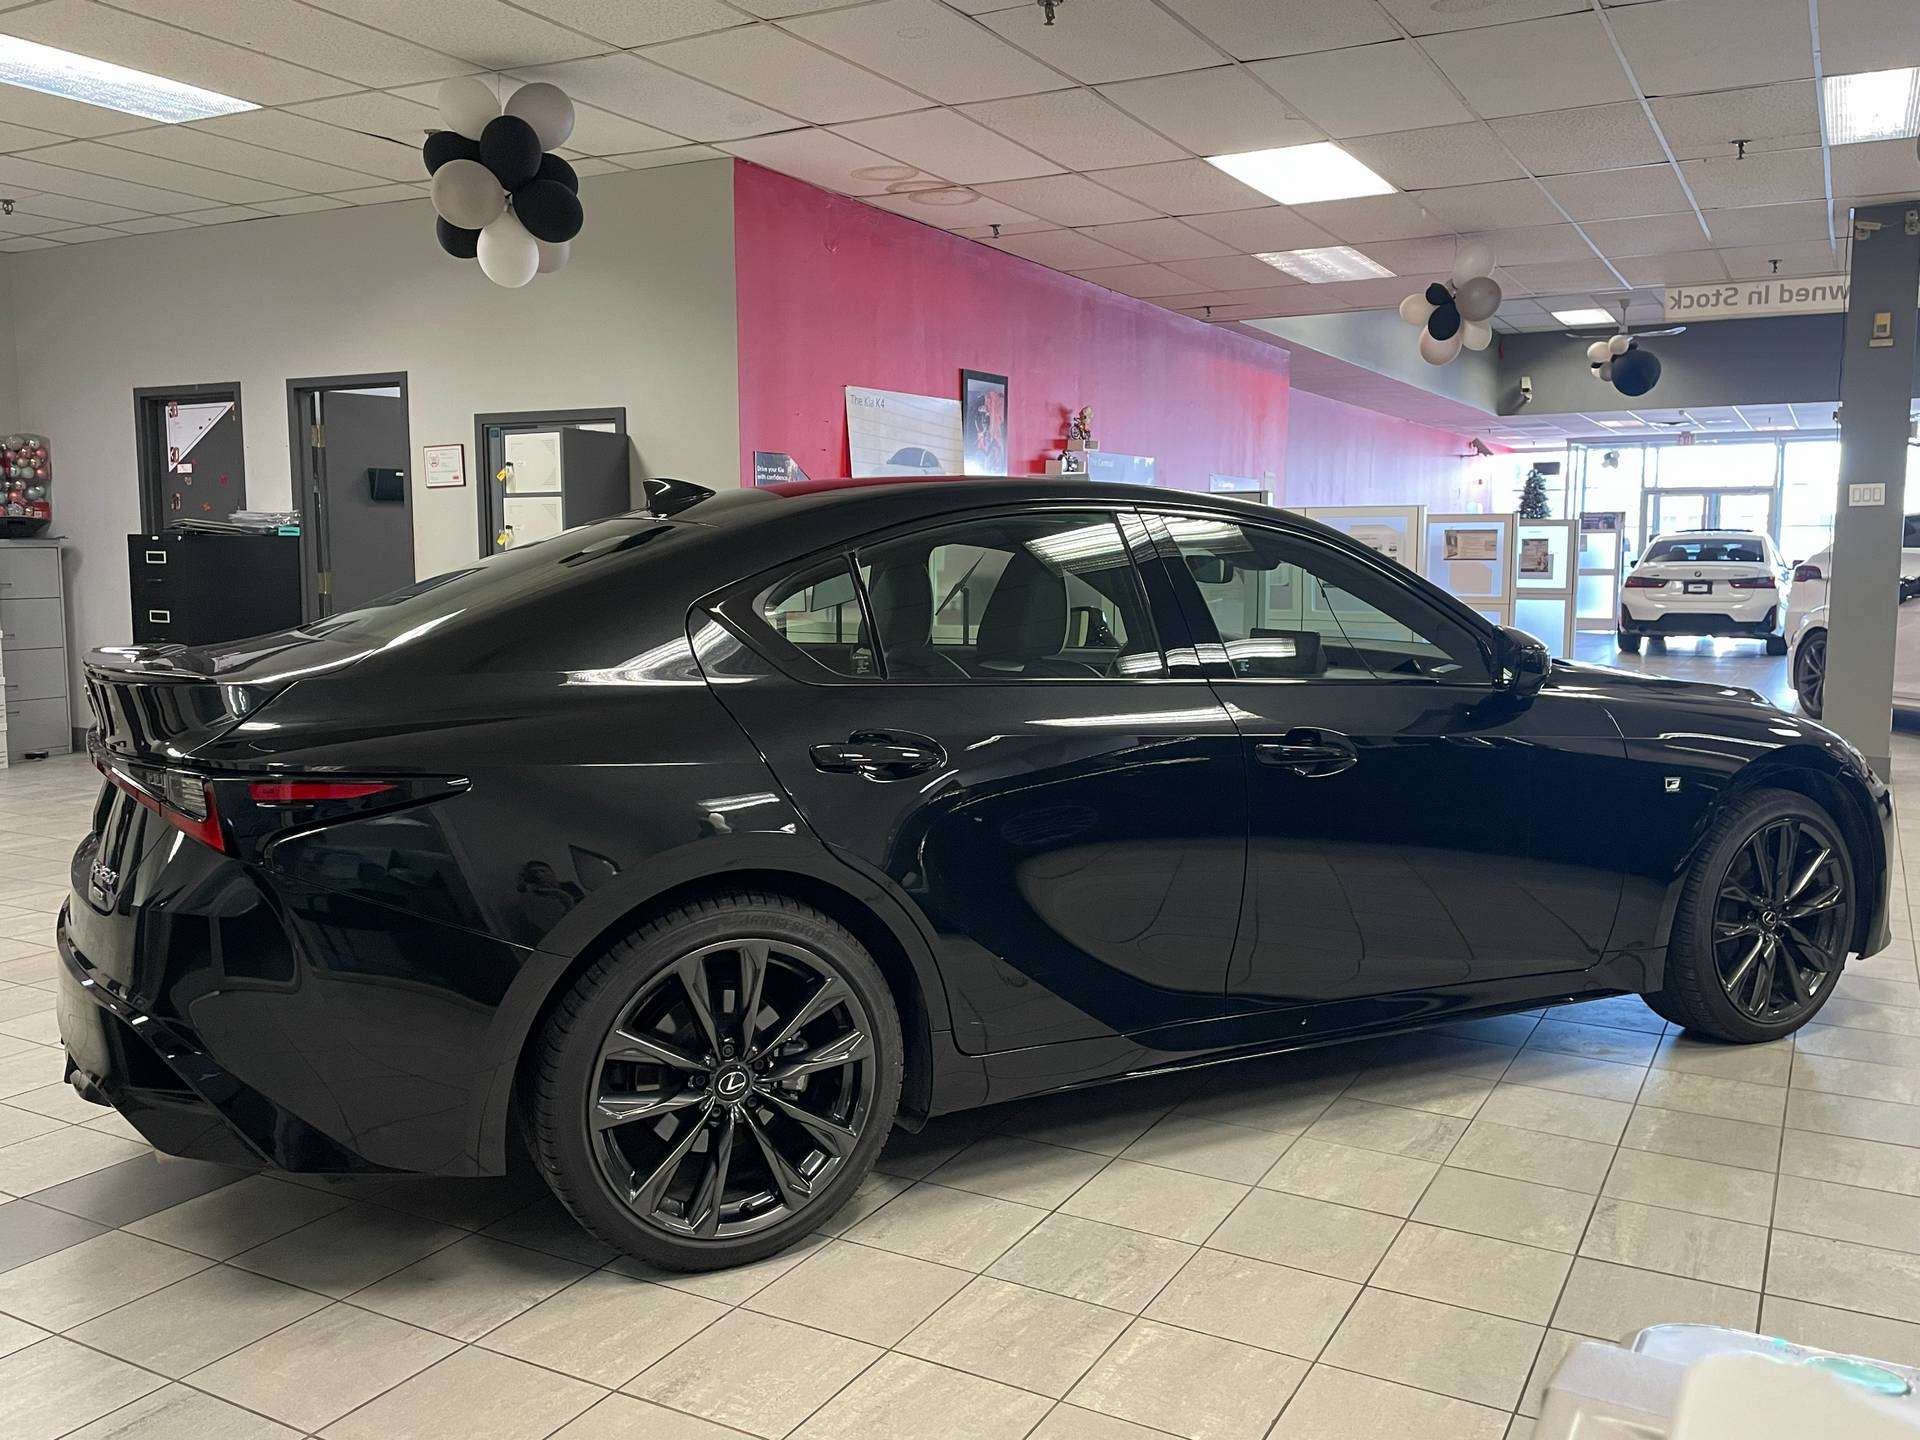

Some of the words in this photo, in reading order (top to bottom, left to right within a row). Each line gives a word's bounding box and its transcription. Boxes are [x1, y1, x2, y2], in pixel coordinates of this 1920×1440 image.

[850, 394, 863, 408] The
[864, 396, 875, 408] Kia
[875, 397, 885, 408] K4
